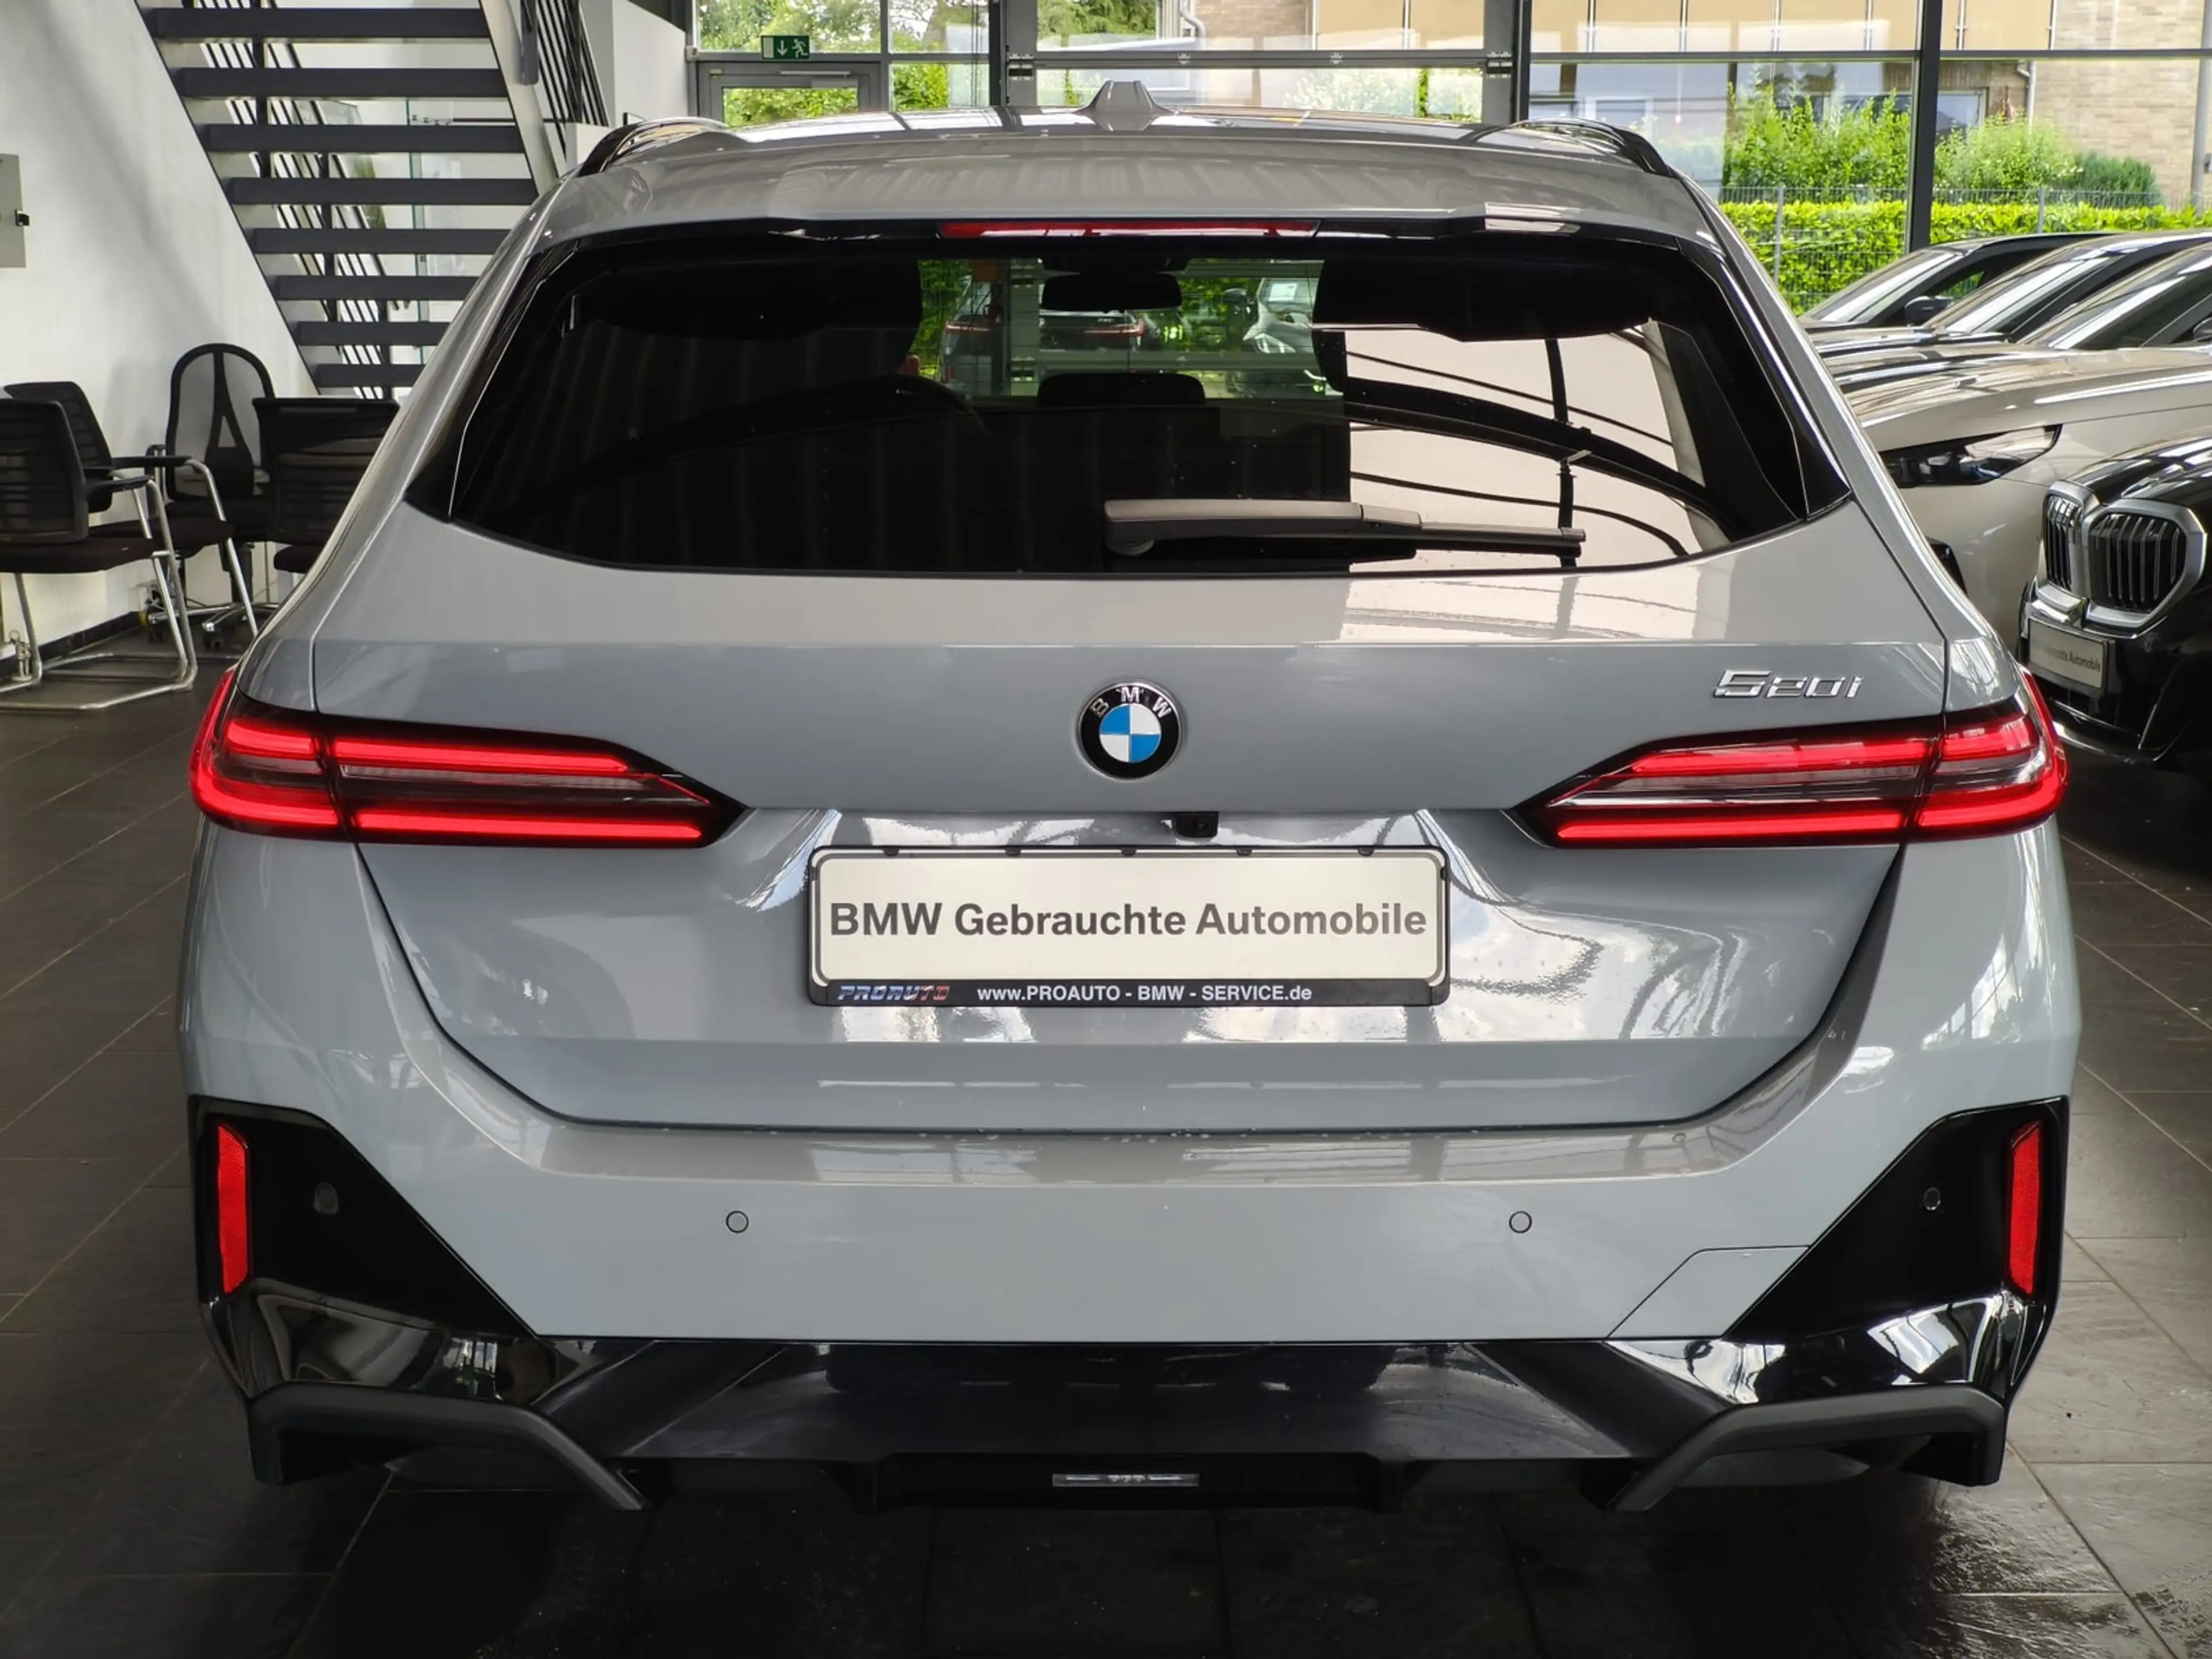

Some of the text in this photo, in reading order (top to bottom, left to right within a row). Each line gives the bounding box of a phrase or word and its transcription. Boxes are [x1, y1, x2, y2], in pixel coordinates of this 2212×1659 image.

[1714, 669, 1864, 698] 520i
[1089, 686, 1172, 718] BMW
[831, 902, 1427, 935] BMW Gebrauchte Automobile
[837, 985, 951, 1001] PROAUTO
[1137, 986, 1185, 1001] BMW
[1201, 985, 1312, 1001] SERVICE.de
